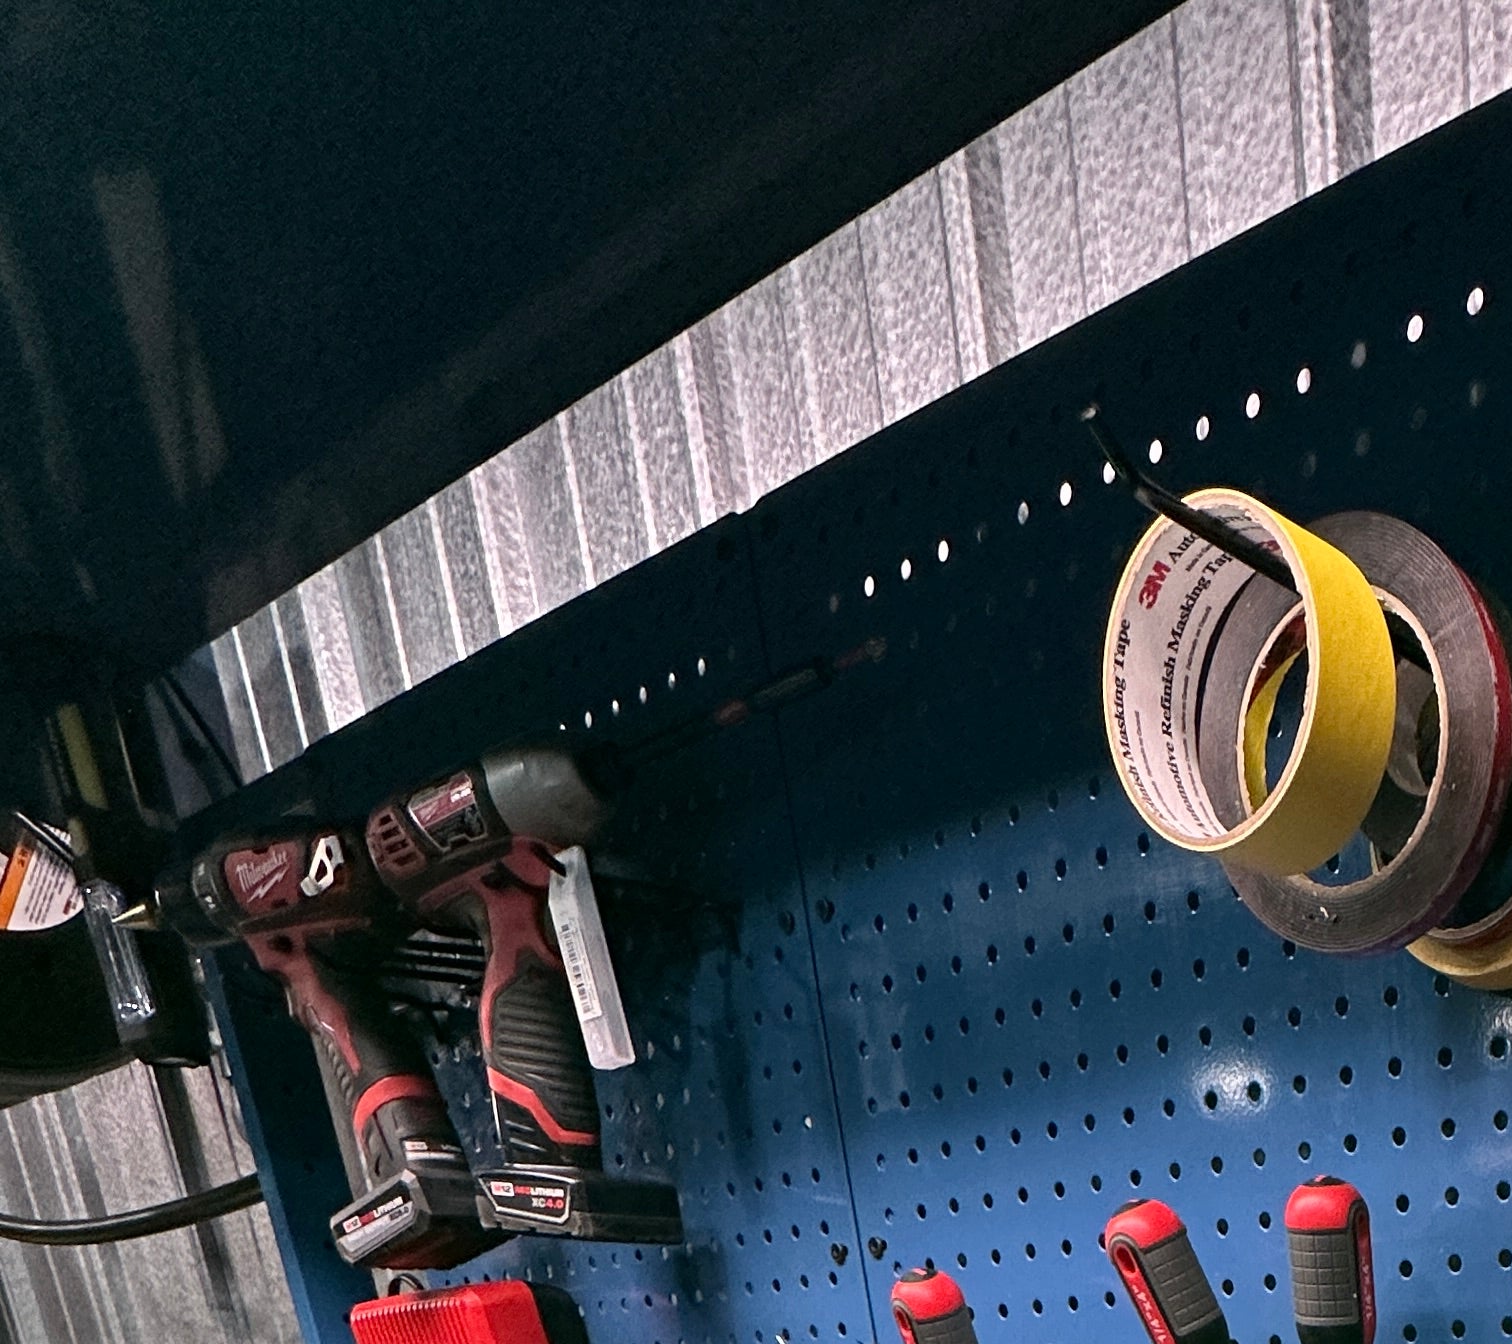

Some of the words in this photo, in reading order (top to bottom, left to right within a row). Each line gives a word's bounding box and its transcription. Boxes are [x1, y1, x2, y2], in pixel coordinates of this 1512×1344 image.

[1139, 561, 1171, 609] 3M
[1168, 532, 1201, 564] Auto
[1202, 552, 1233, 576] Tap
[1113, 618, 1131, 671] Tape
[1167, 575, 1212, 654] Masking
[1114, 677, 1134, 762] Masking
[1161, 656, 1176, 738] Refinish
[1166, 741, 1208, 831] Automotive
